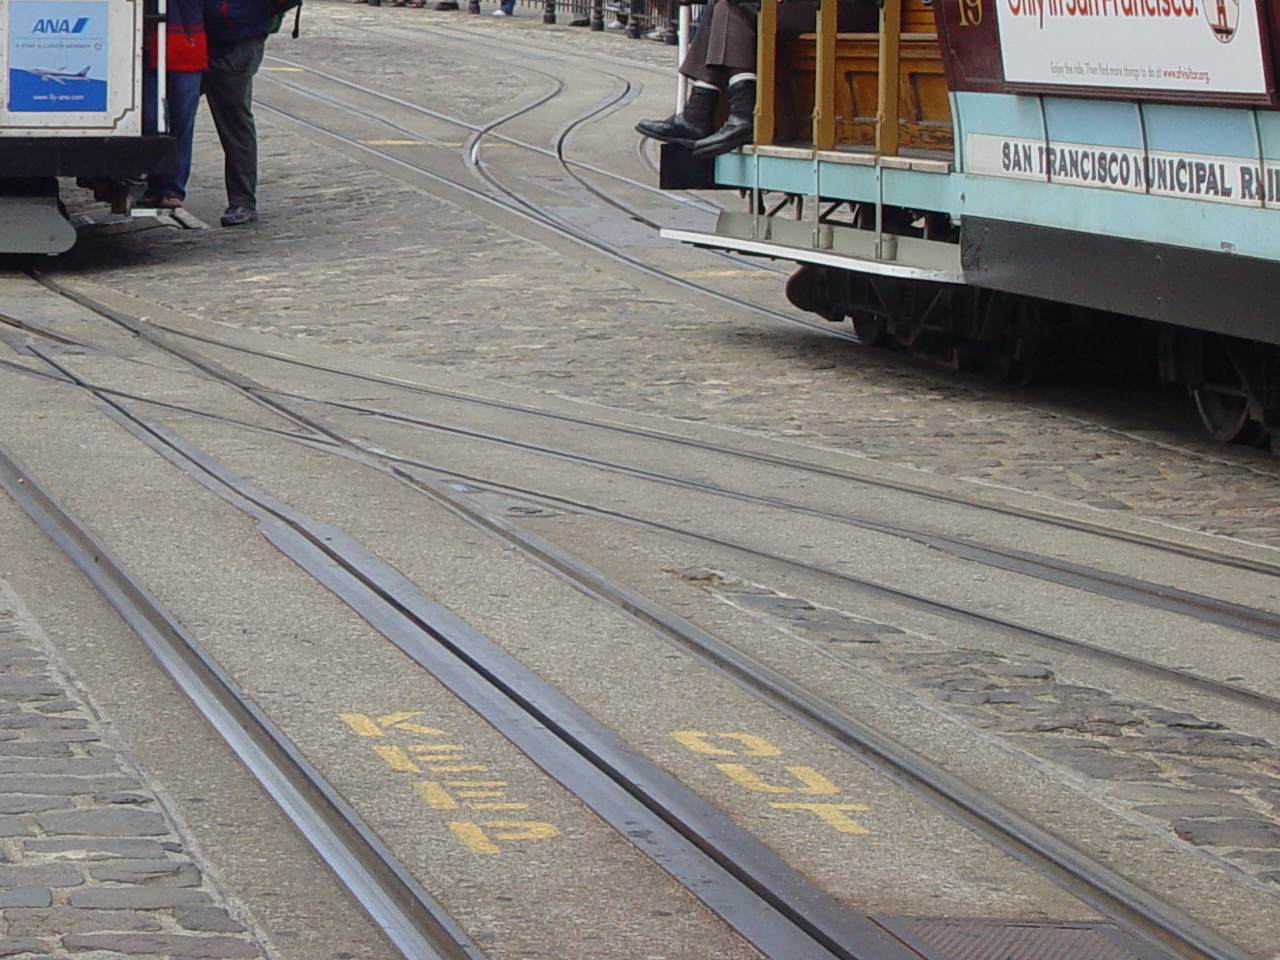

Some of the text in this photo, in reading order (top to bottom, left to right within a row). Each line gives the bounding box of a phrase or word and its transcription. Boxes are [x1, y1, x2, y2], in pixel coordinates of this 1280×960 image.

[32, 18, 70, 34] ANA
[1002, 141, 1033, 173] SAN
[1037, 145, 1130, 186] FRANCISCO
[1132, 155, 1233, 198] MUNICIPAL
[337, 711, 563, 855] KEEP
